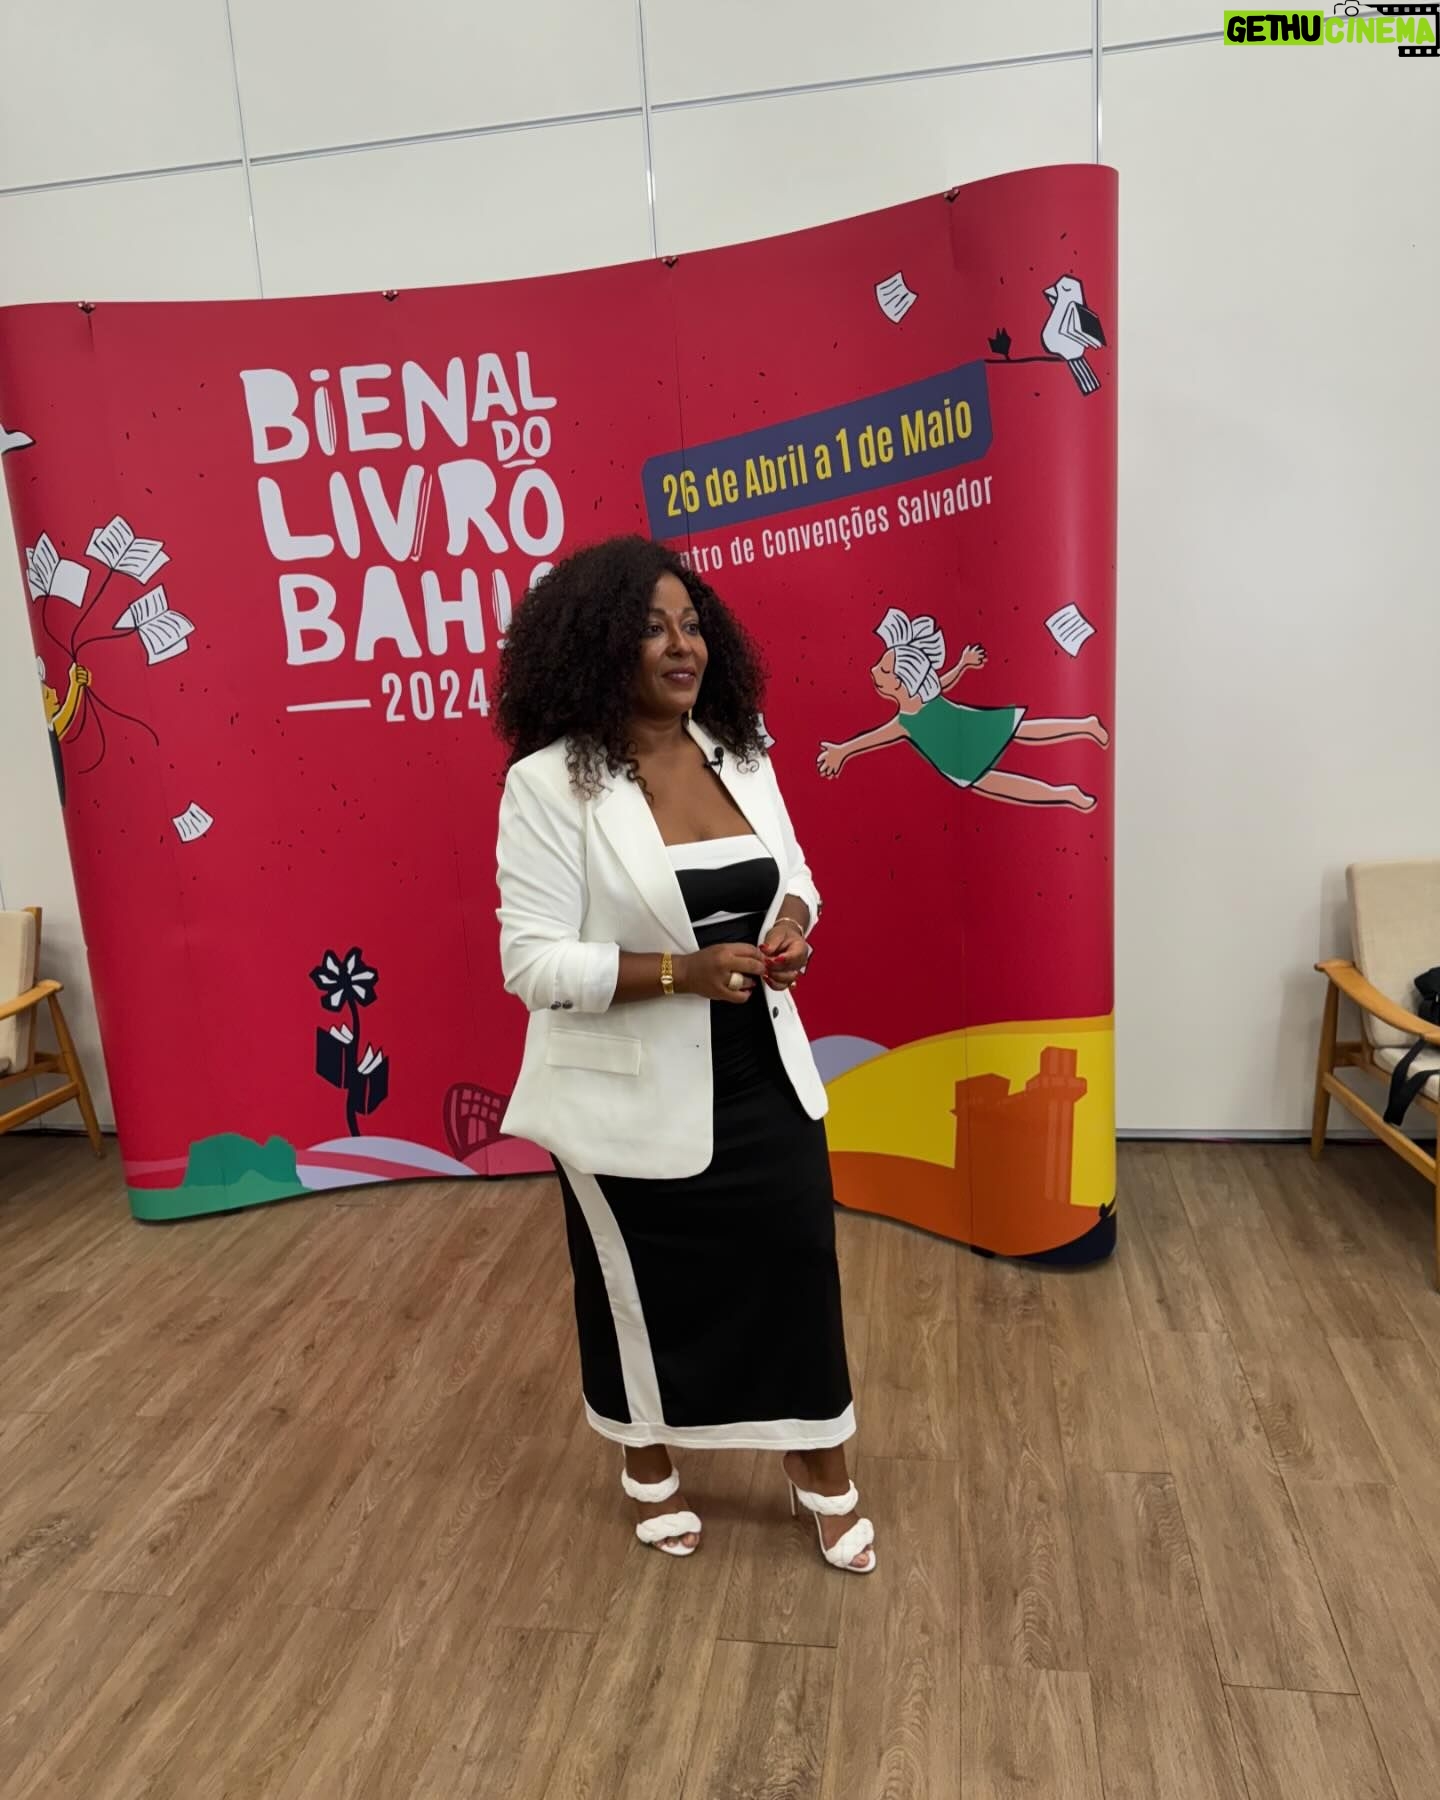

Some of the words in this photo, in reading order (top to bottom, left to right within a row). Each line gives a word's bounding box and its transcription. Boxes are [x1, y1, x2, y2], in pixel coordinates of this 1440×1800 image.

[492, 416, 552, 462] DO
[662, 469, 700, 517] 26
[705, 467, 739, 508] de
[745, 444, 808, 499] Abril
[814, 443, 832, 480] a
[835, 428, 852, 474] 1
[858, 426, 894, 469] de
[900, 398, 973, 457] Maio
[257, 459, 564, 562] LIVRO
[679, 544, 723, 574] ntro
[730, 536, 755, 566] de
[761, 505, 889, 558] Convenções
[897, 475, 993, 528] Salvador
[381, 668, 490, 722] 2024
